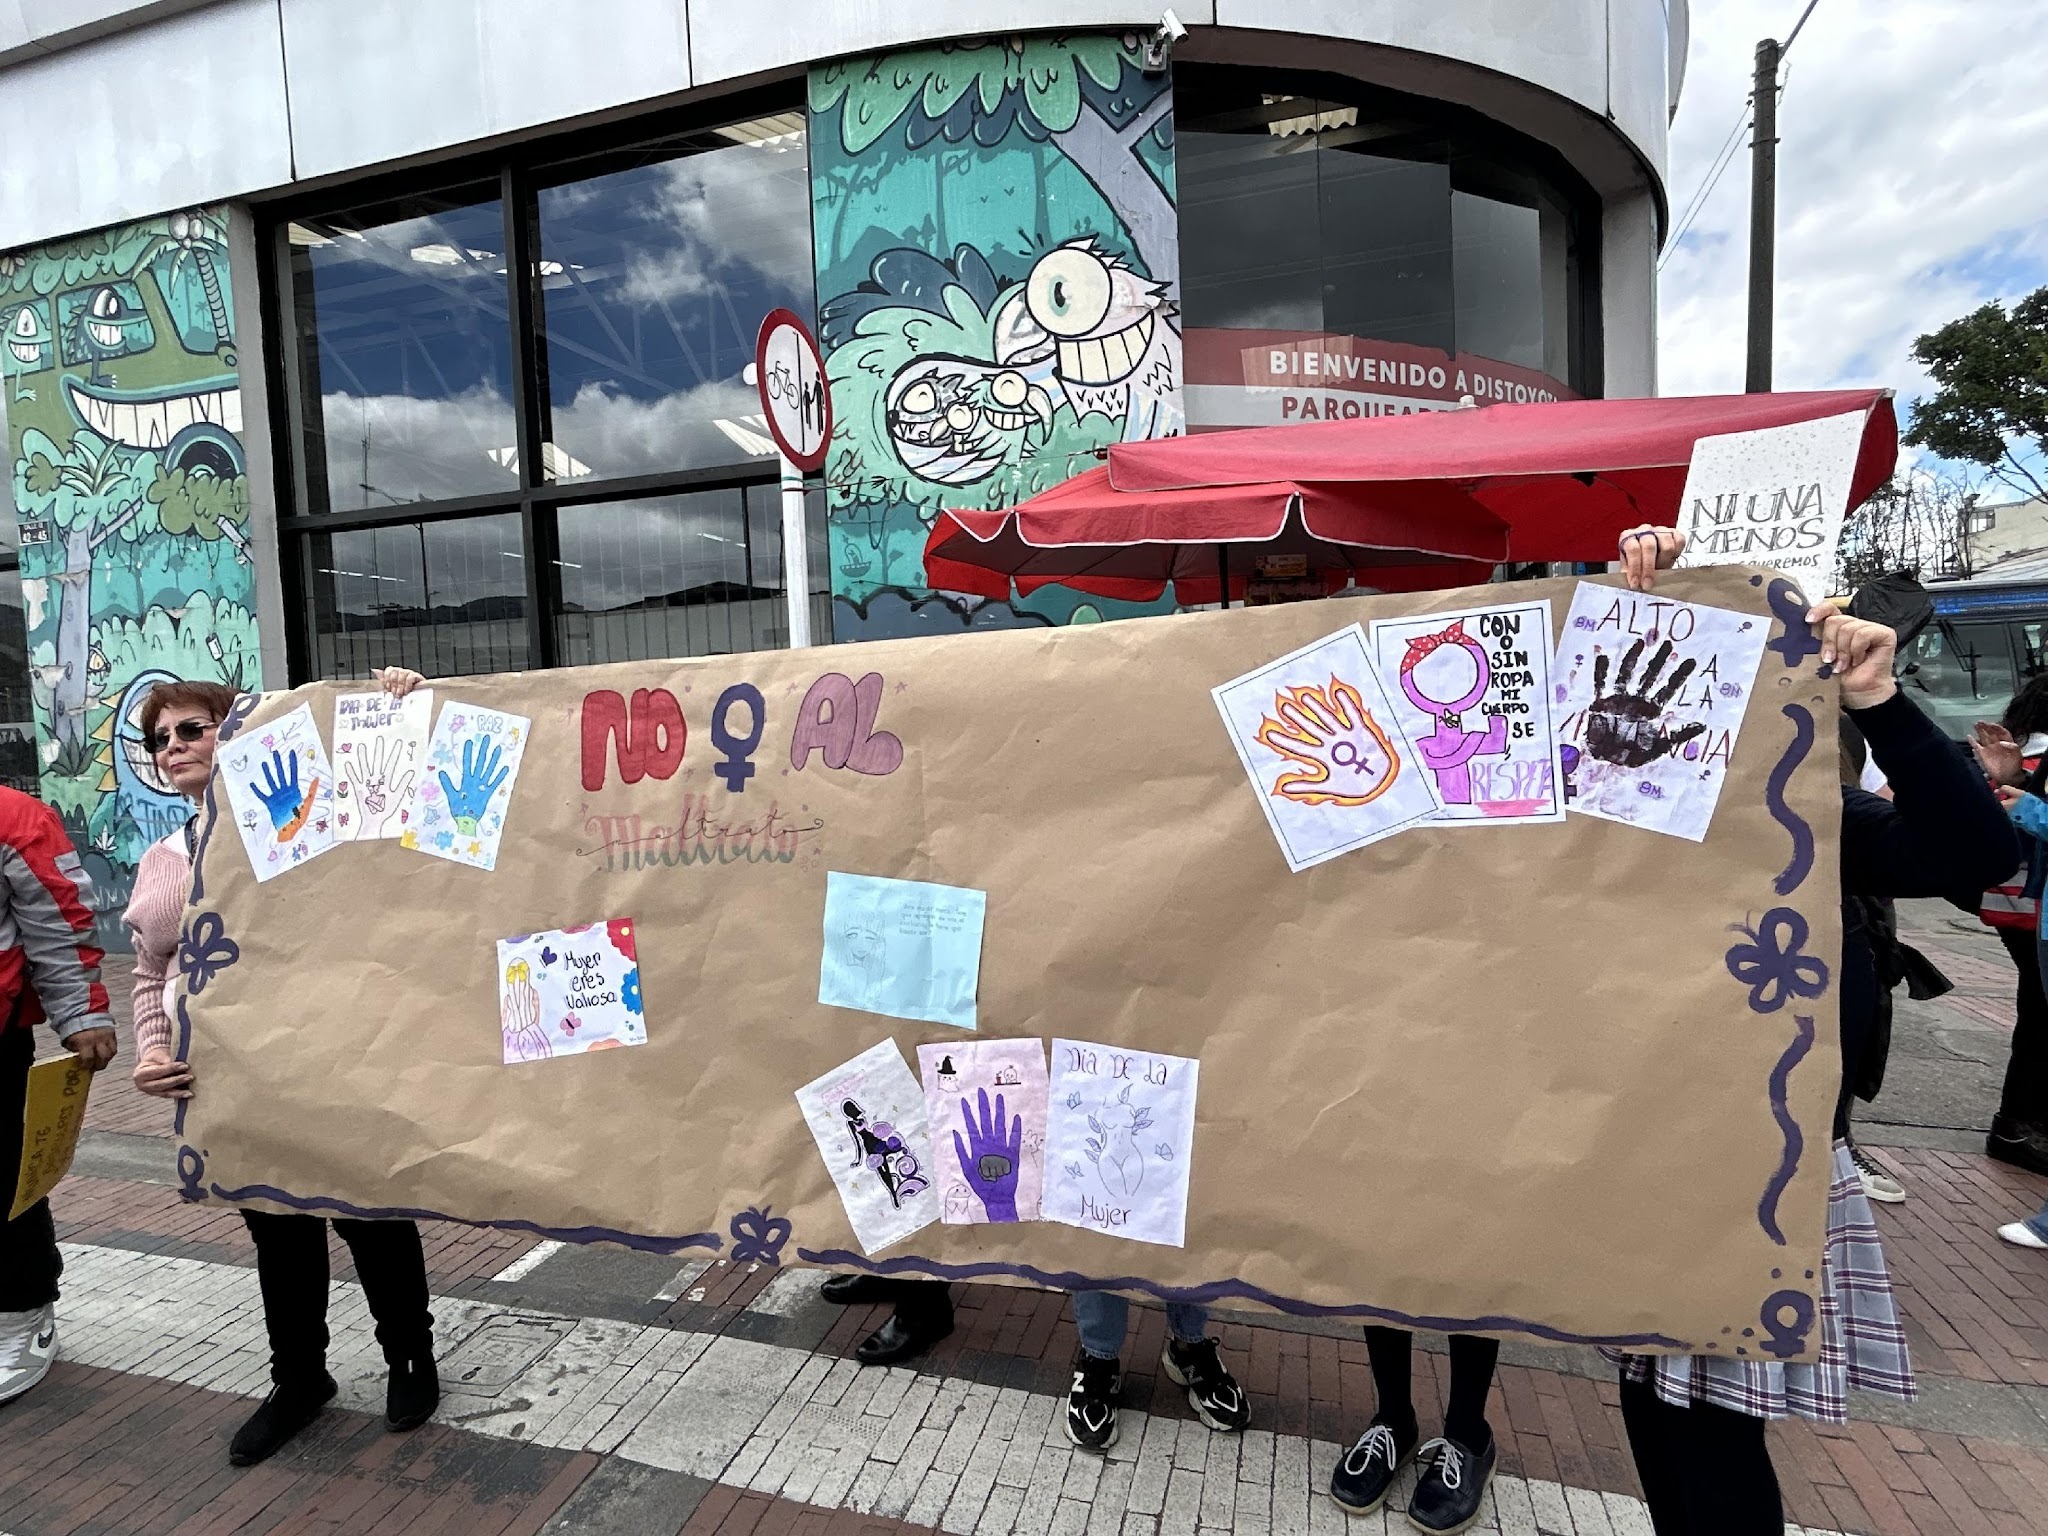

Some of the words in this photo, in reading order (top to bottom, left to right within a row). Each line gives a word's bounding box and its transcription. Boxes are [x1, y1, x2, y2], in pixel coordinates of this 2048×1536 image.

[1269, 350, 1446, 388] BIENVENIDO
[1454, 371, 1468, 393] A
[1473, 373, 1558, 404] DISTOYO
[1689, 493, 1739, 530] NI
[1746, 483, 1825, 523] UNA
[1684, 517, 1826, 554] MENOS
[1479, 614, 1520, 637] CON
[1596, 597, 1695, 642] ALTO
[1499, 635, 1513, 650] O
[1491, 651, 1528, 669] SIN
[1699, 653, 1718, 682] A
[1491, 670, 1534, 689] ROPA
[1501, 688, 1521, 701] MI
[1677, 684, 1713, 710] LA
[1481, 702, 1529, 717] CUERPO
[581, 687, 688, 791] NO
[790, 672, 904, 776] AL
[1513, 721, 1535, 738] SE
[564, 950, 601, 975] Mujer
[571, 973, 604, 991] eres
[1080, 1193, 1132, 1228] Mujer
